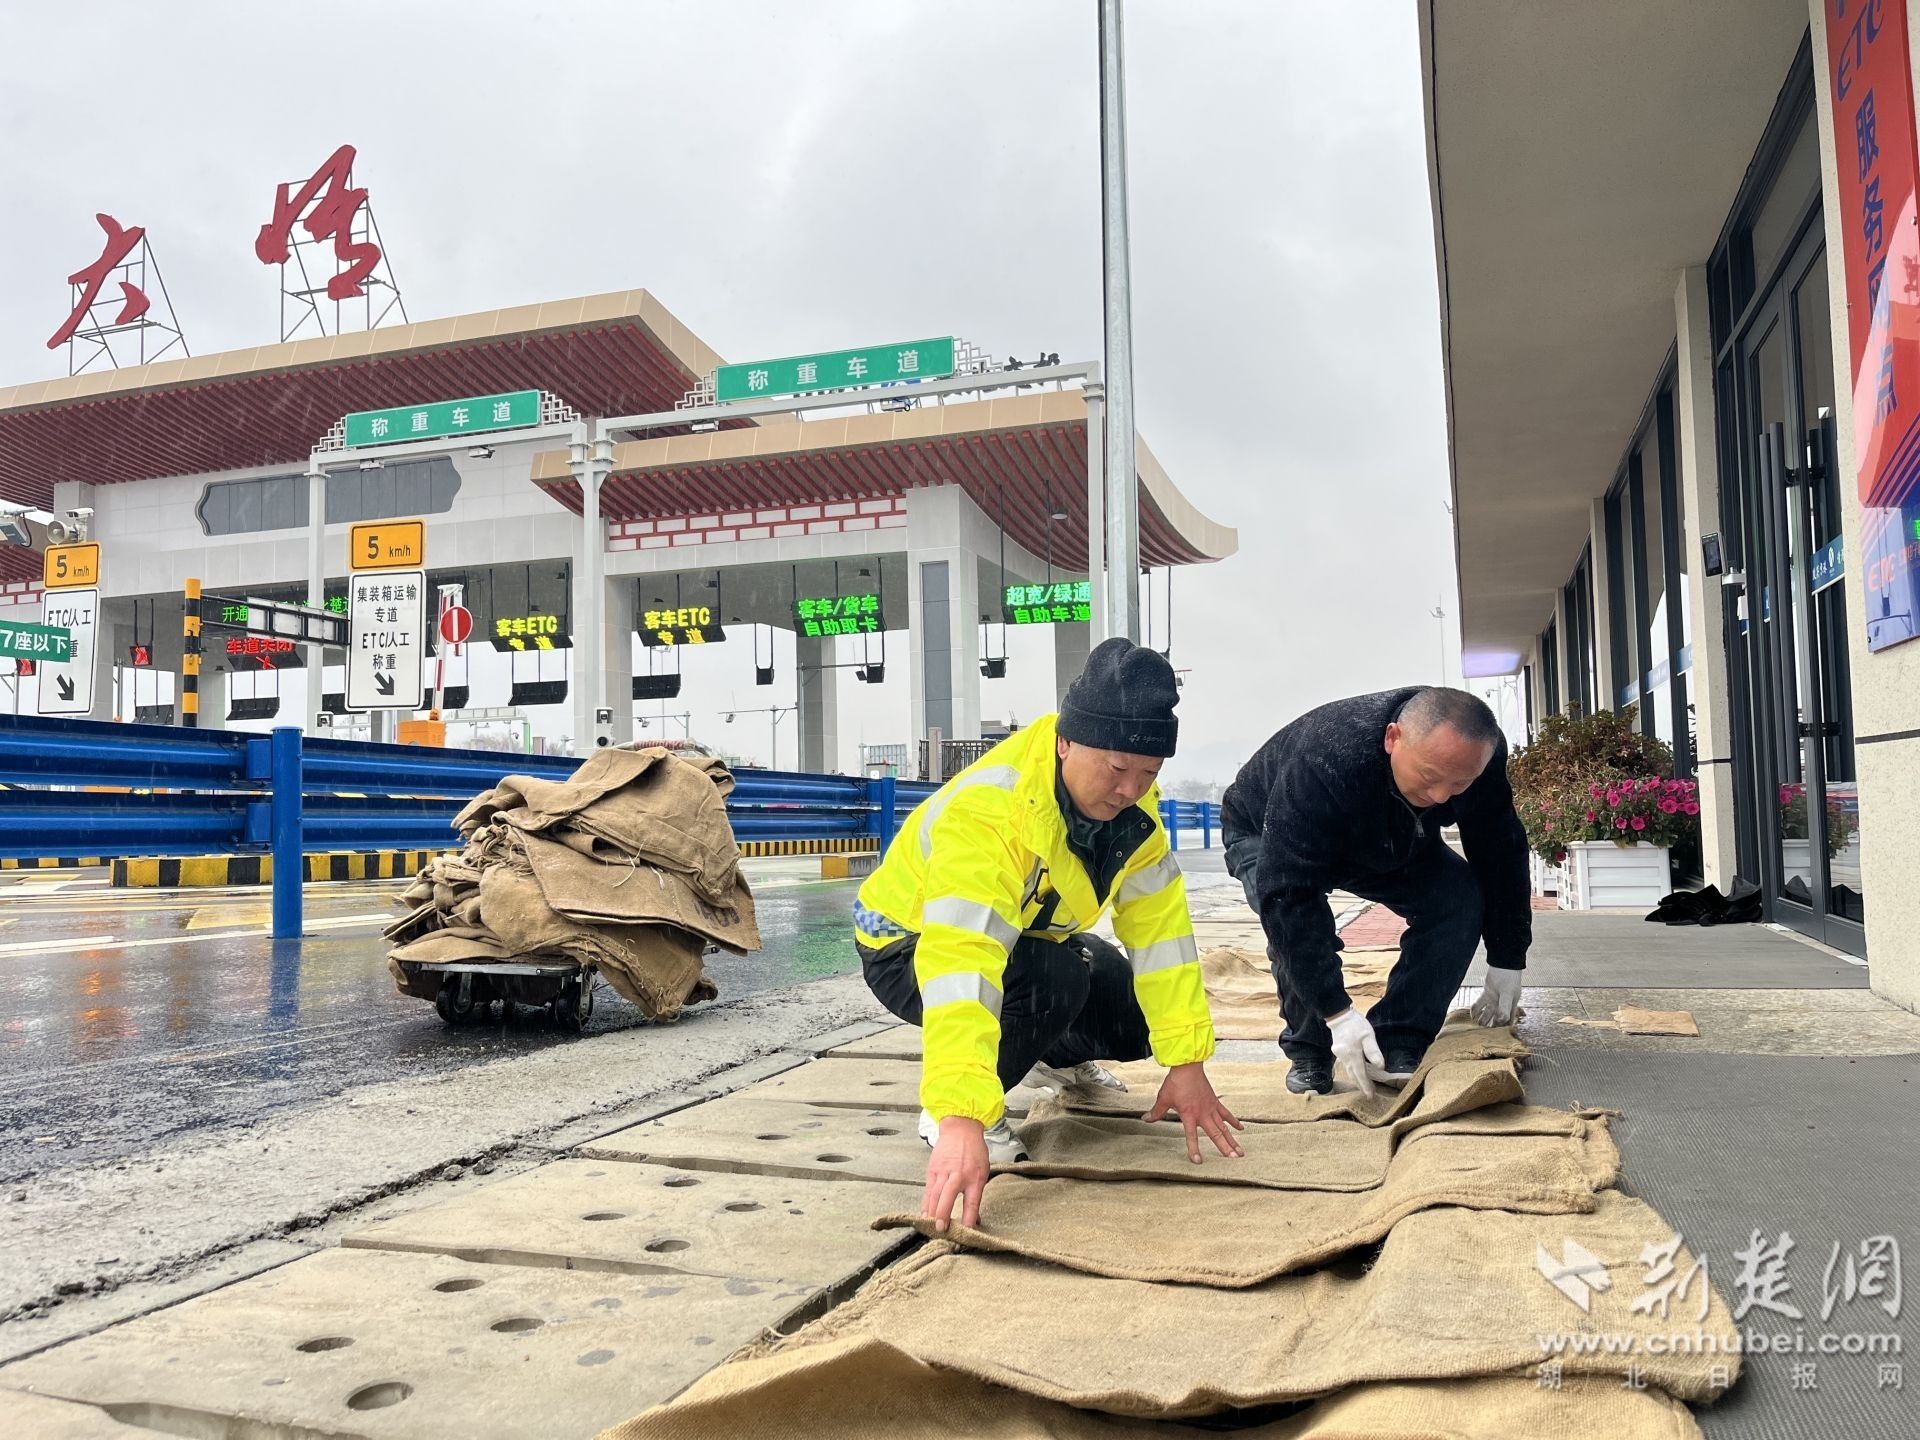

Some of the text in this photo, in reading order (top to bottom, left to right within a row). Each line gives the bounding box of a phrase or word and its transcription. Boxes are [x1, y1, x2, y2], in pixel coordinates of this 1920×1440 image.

[746, 349, 919, 391] 称重车道
[371, 402, 511, 437] 称重车道
[367, 535, 411, 559] 5 km/h
[56, 555, 90, 578] 5 km/h
[357, 584, 417, 602] 集装箱运输
[1006, 581, 1091, 605] 超宽/绿通
[374, 607, 398, 623] 专道
[798, 594, 879, 618] 客车/货车
[1013, 604, 1091, 623] 自助车道
[496, 616, 558, 635] 客车ETC
[643, 607, 711, 629] 客车ETC
[804, 616, 878, 637] 自助取卡
[0, 629, 68, 654] 7座以下
[362, 632, 410, 648] ETC/人工
[508, 636, 555, 651] 专道
[657, 628, 706, 646] 专道
[372, 654, 397, 670] 称重
